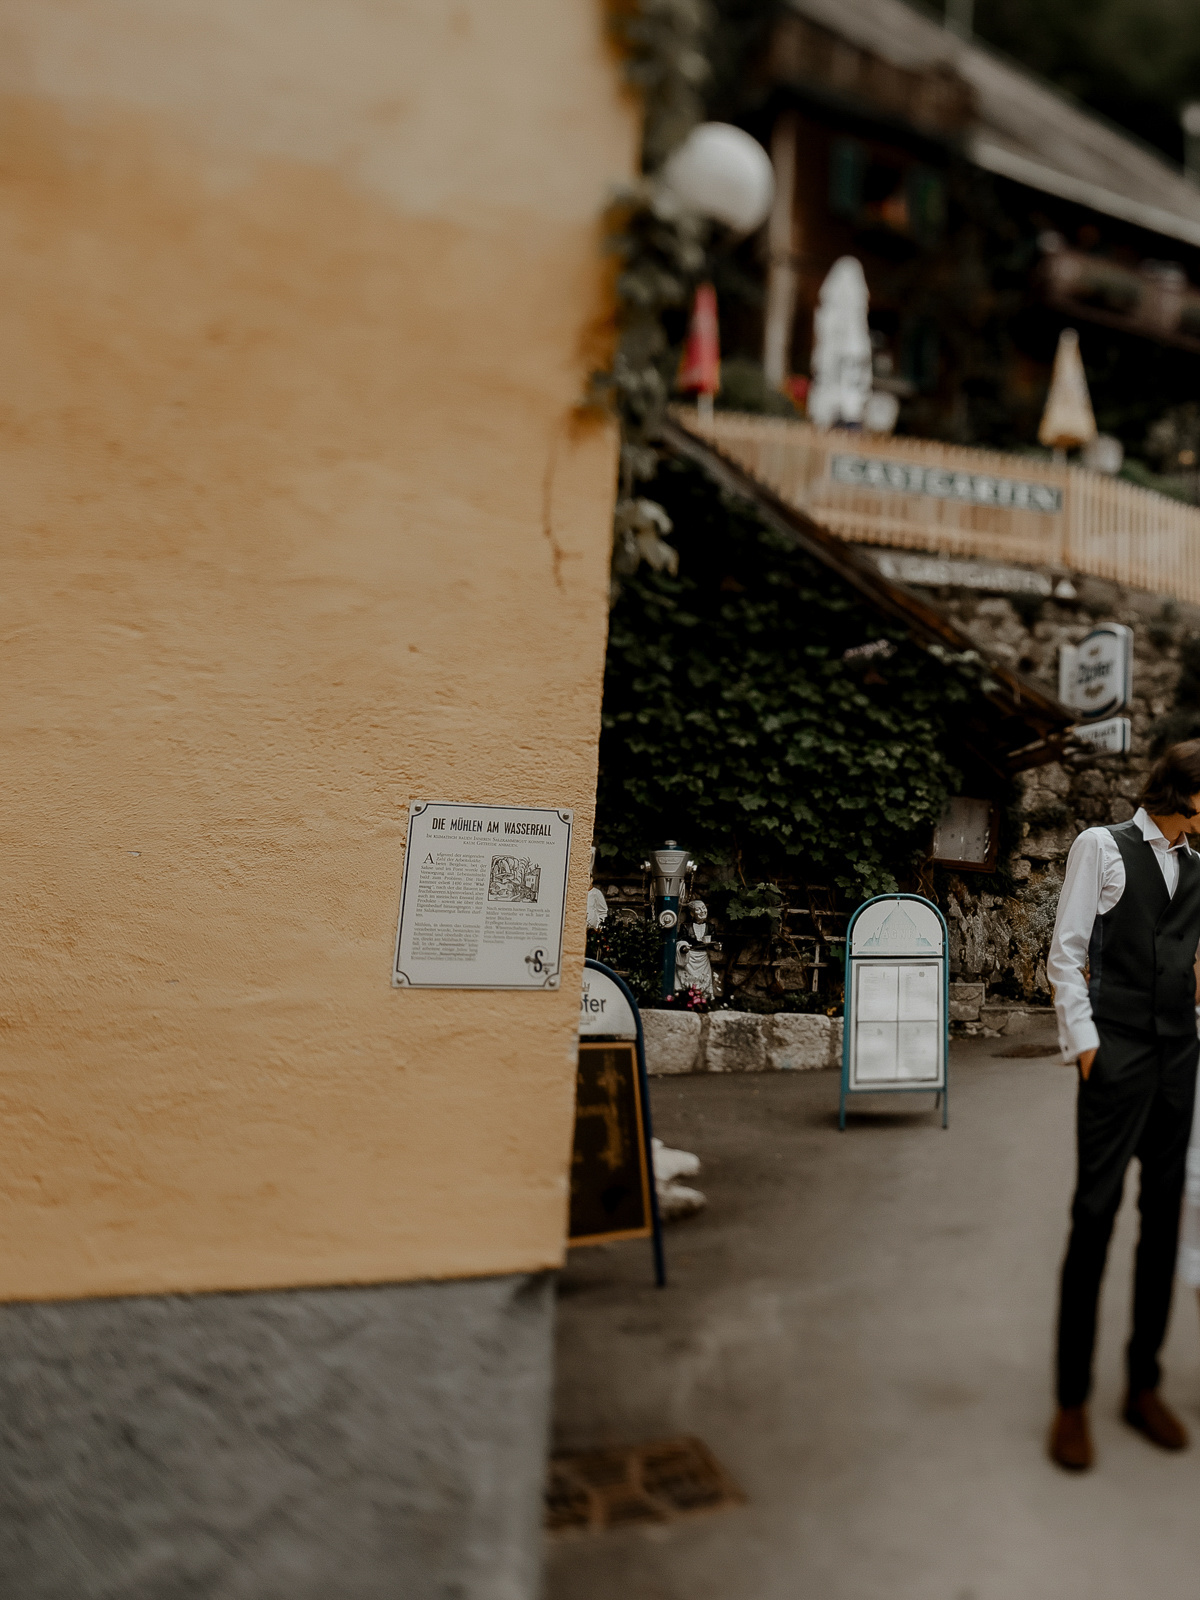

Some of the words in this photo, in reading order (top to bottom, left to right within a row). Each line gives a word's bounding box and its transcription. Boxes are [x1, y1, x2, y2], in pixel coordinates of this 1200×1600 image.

[432, 818, 446, 830] DIE
[450, 817, 483, 832] MÜHLEN
[487, 822, 499, 833] AM
[505, 822, 552, 836] WASSERFALL
